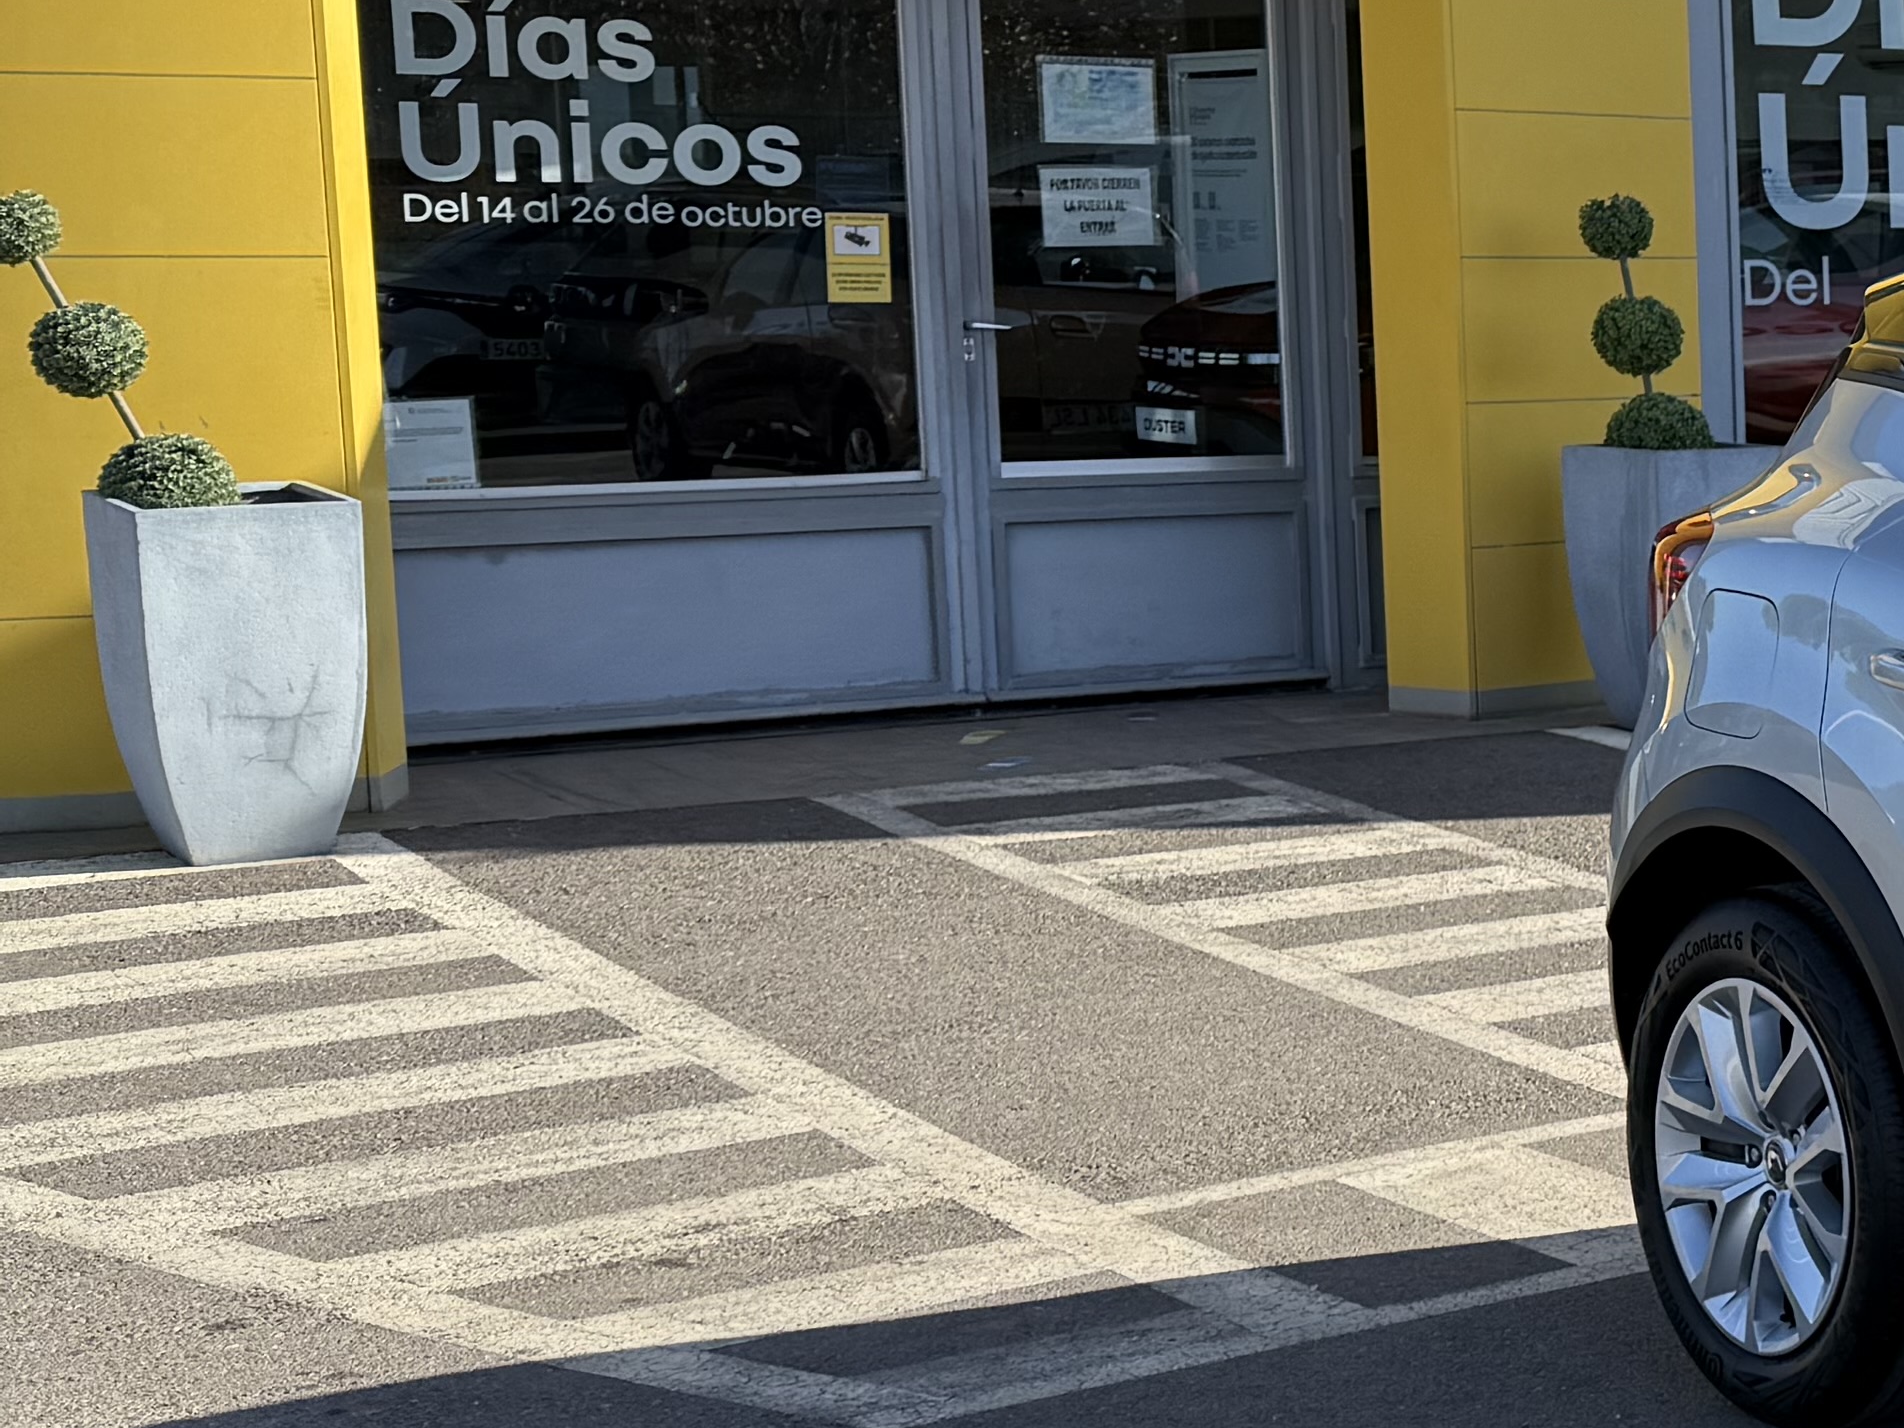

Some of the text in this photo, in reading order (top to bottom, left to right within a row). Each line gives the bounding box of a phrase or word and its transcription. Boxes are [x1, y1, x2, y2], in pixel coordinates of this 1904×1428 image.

[399, 81, 802, 188] Únicos
[401, 190, 824, 230] Del 14 al 26 de octubre
[1743, 256, 1830, 307] Del
[1143, 418, 1186, 434] DUSTER
[1665, 930, 1743, 981] EcoContact 6
